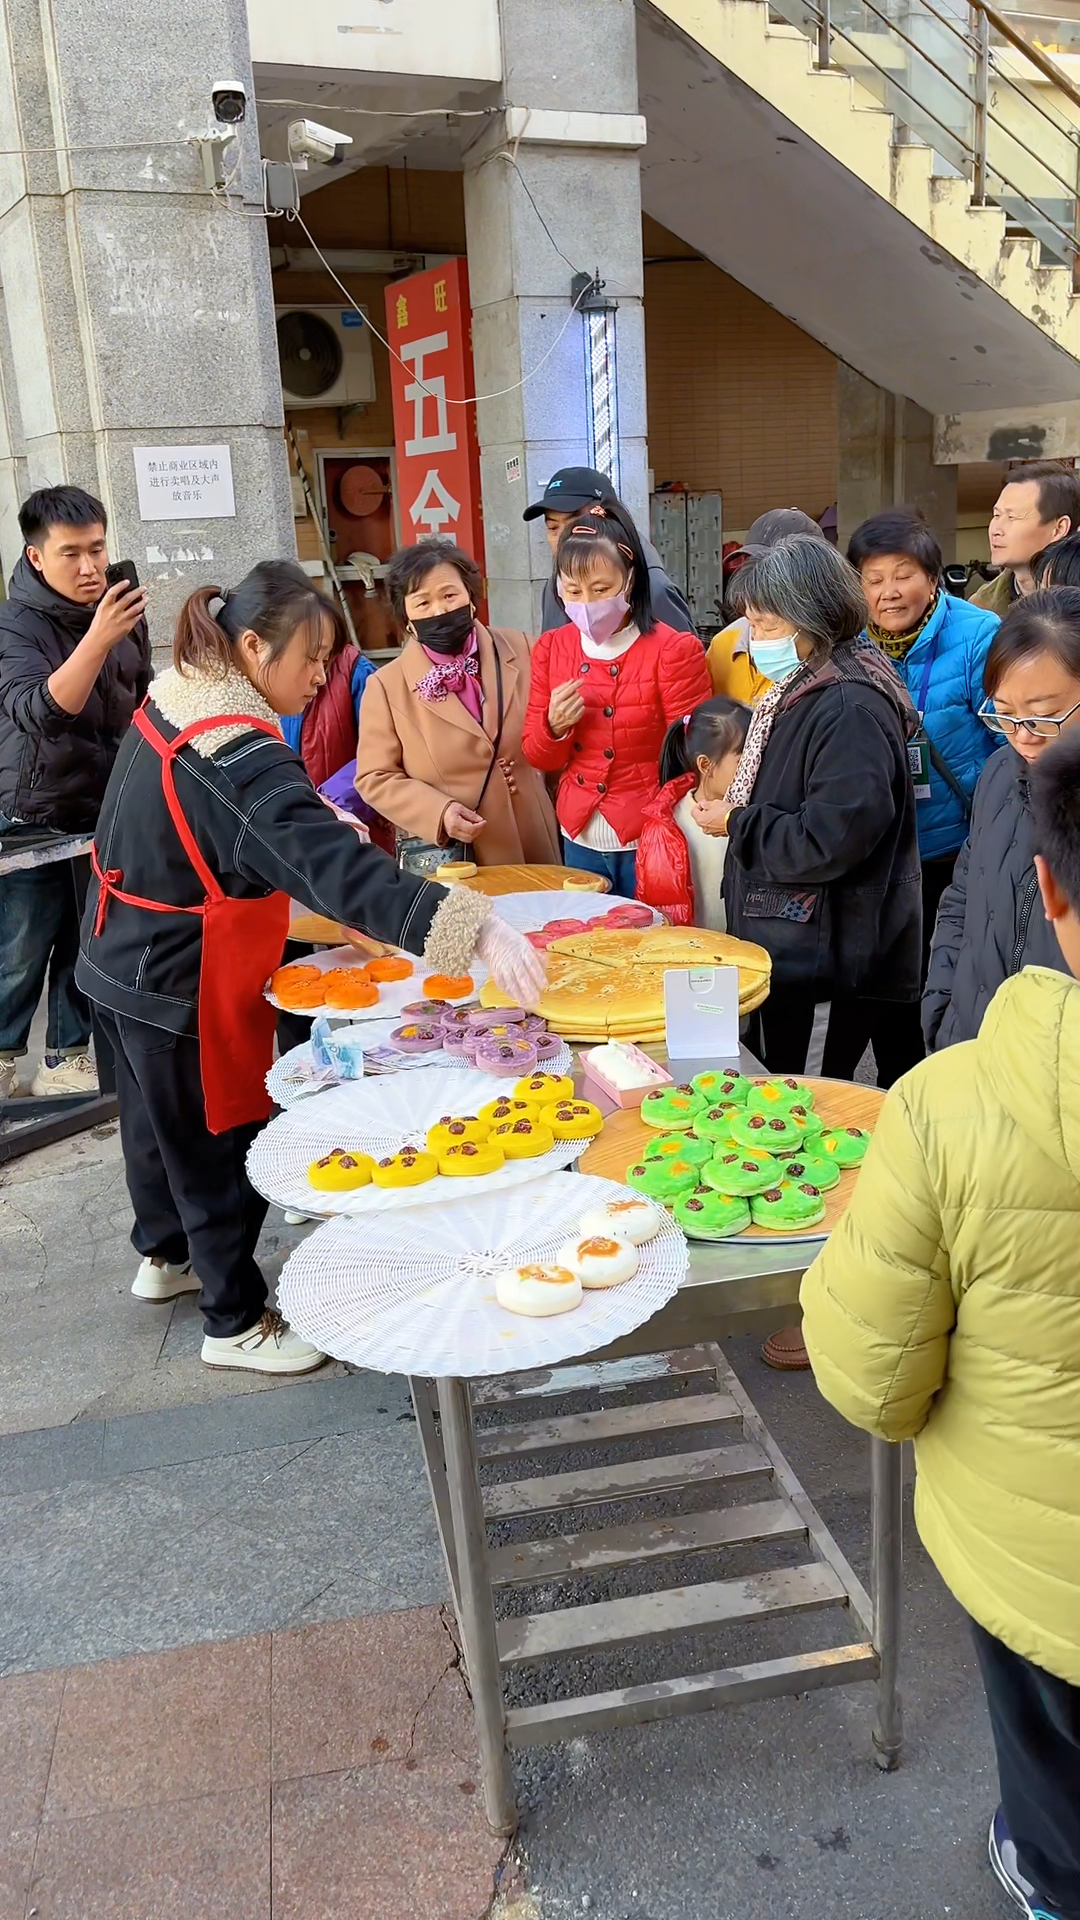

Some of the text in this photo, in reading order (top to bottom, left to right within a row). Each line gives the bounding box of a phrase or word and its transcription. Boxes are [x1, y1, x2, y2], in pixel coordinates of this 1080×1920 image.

[400, 330, 461, 548] 五金
[147, 459, 218, 472] 禁止商业区域内
[149, 474, 220, 488] 进行卖唱及大声
[172, 490, 202, 501] 放音乐
